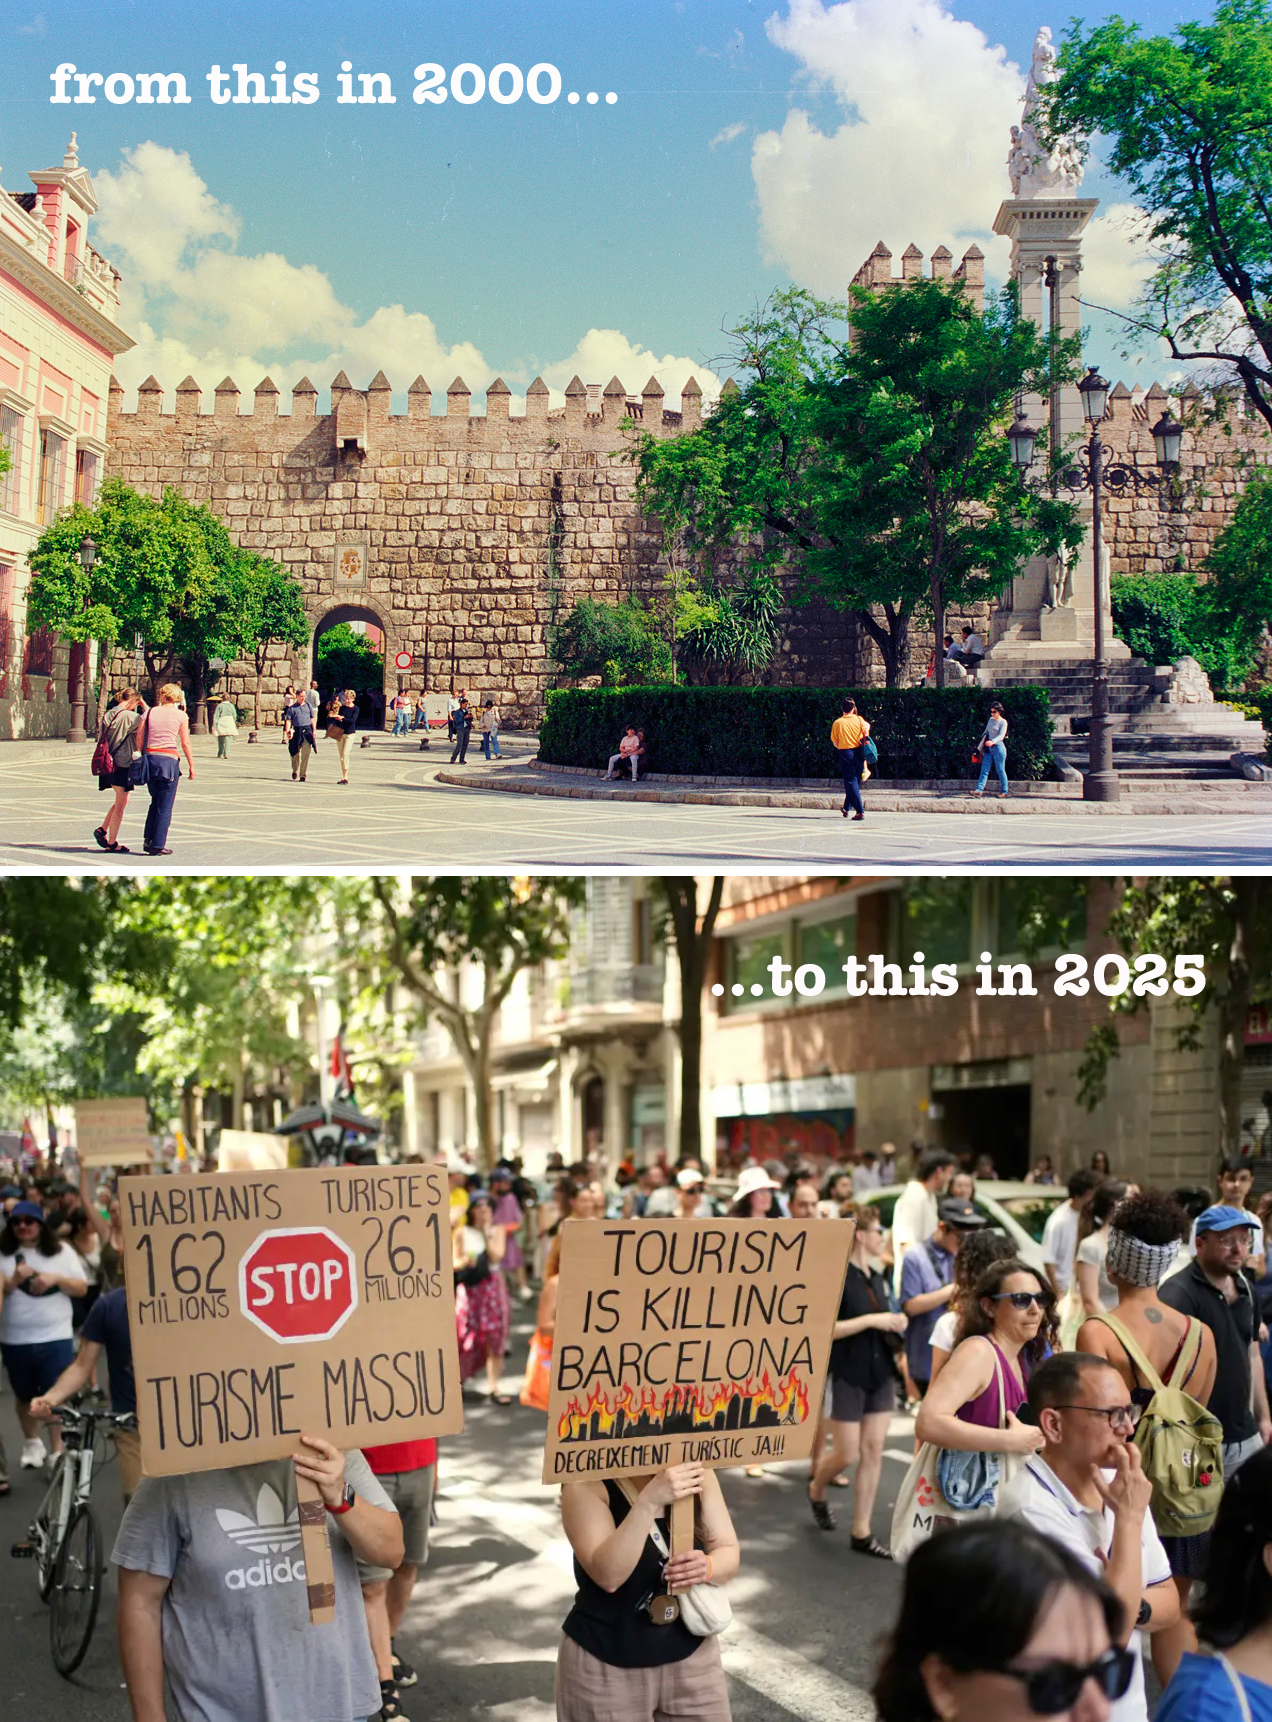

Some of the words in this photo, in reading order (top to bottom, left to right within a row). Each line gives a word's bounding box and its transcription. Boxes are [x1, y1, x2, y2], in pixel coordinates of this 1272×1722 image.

[127, 1183, 282, 1227] HABITANTS
[320, 1174, 442, 1214] TURISTES
[136, 1231, 227, 1298] 1.62
[361, 1212, 442, 1279] 26.1
[603, 1229, 807, 1276] TOURISM
[250, 1259, 344, 1307] STOP
[364, 1273, 443, 1304] MILIONS
[139, 1293, 230, 1325] MILIONS
[583, 1289, 620, 1333] IS
[641, 1283, 808, 1332] KILLING
[557, 1336, 813, 1391] BARCELONA
[146, 1363, 301, 1450] TURISME
[323, 1348, 445, 1429] MASSIU
[554, 1441, 671, 1474] DECREIXEMENT
[681, 1436, 744, 1463] TURÍSTIC
[751, 1434, 785, 1457] JA!!!
[224, 1555, 307, 1590] adida
